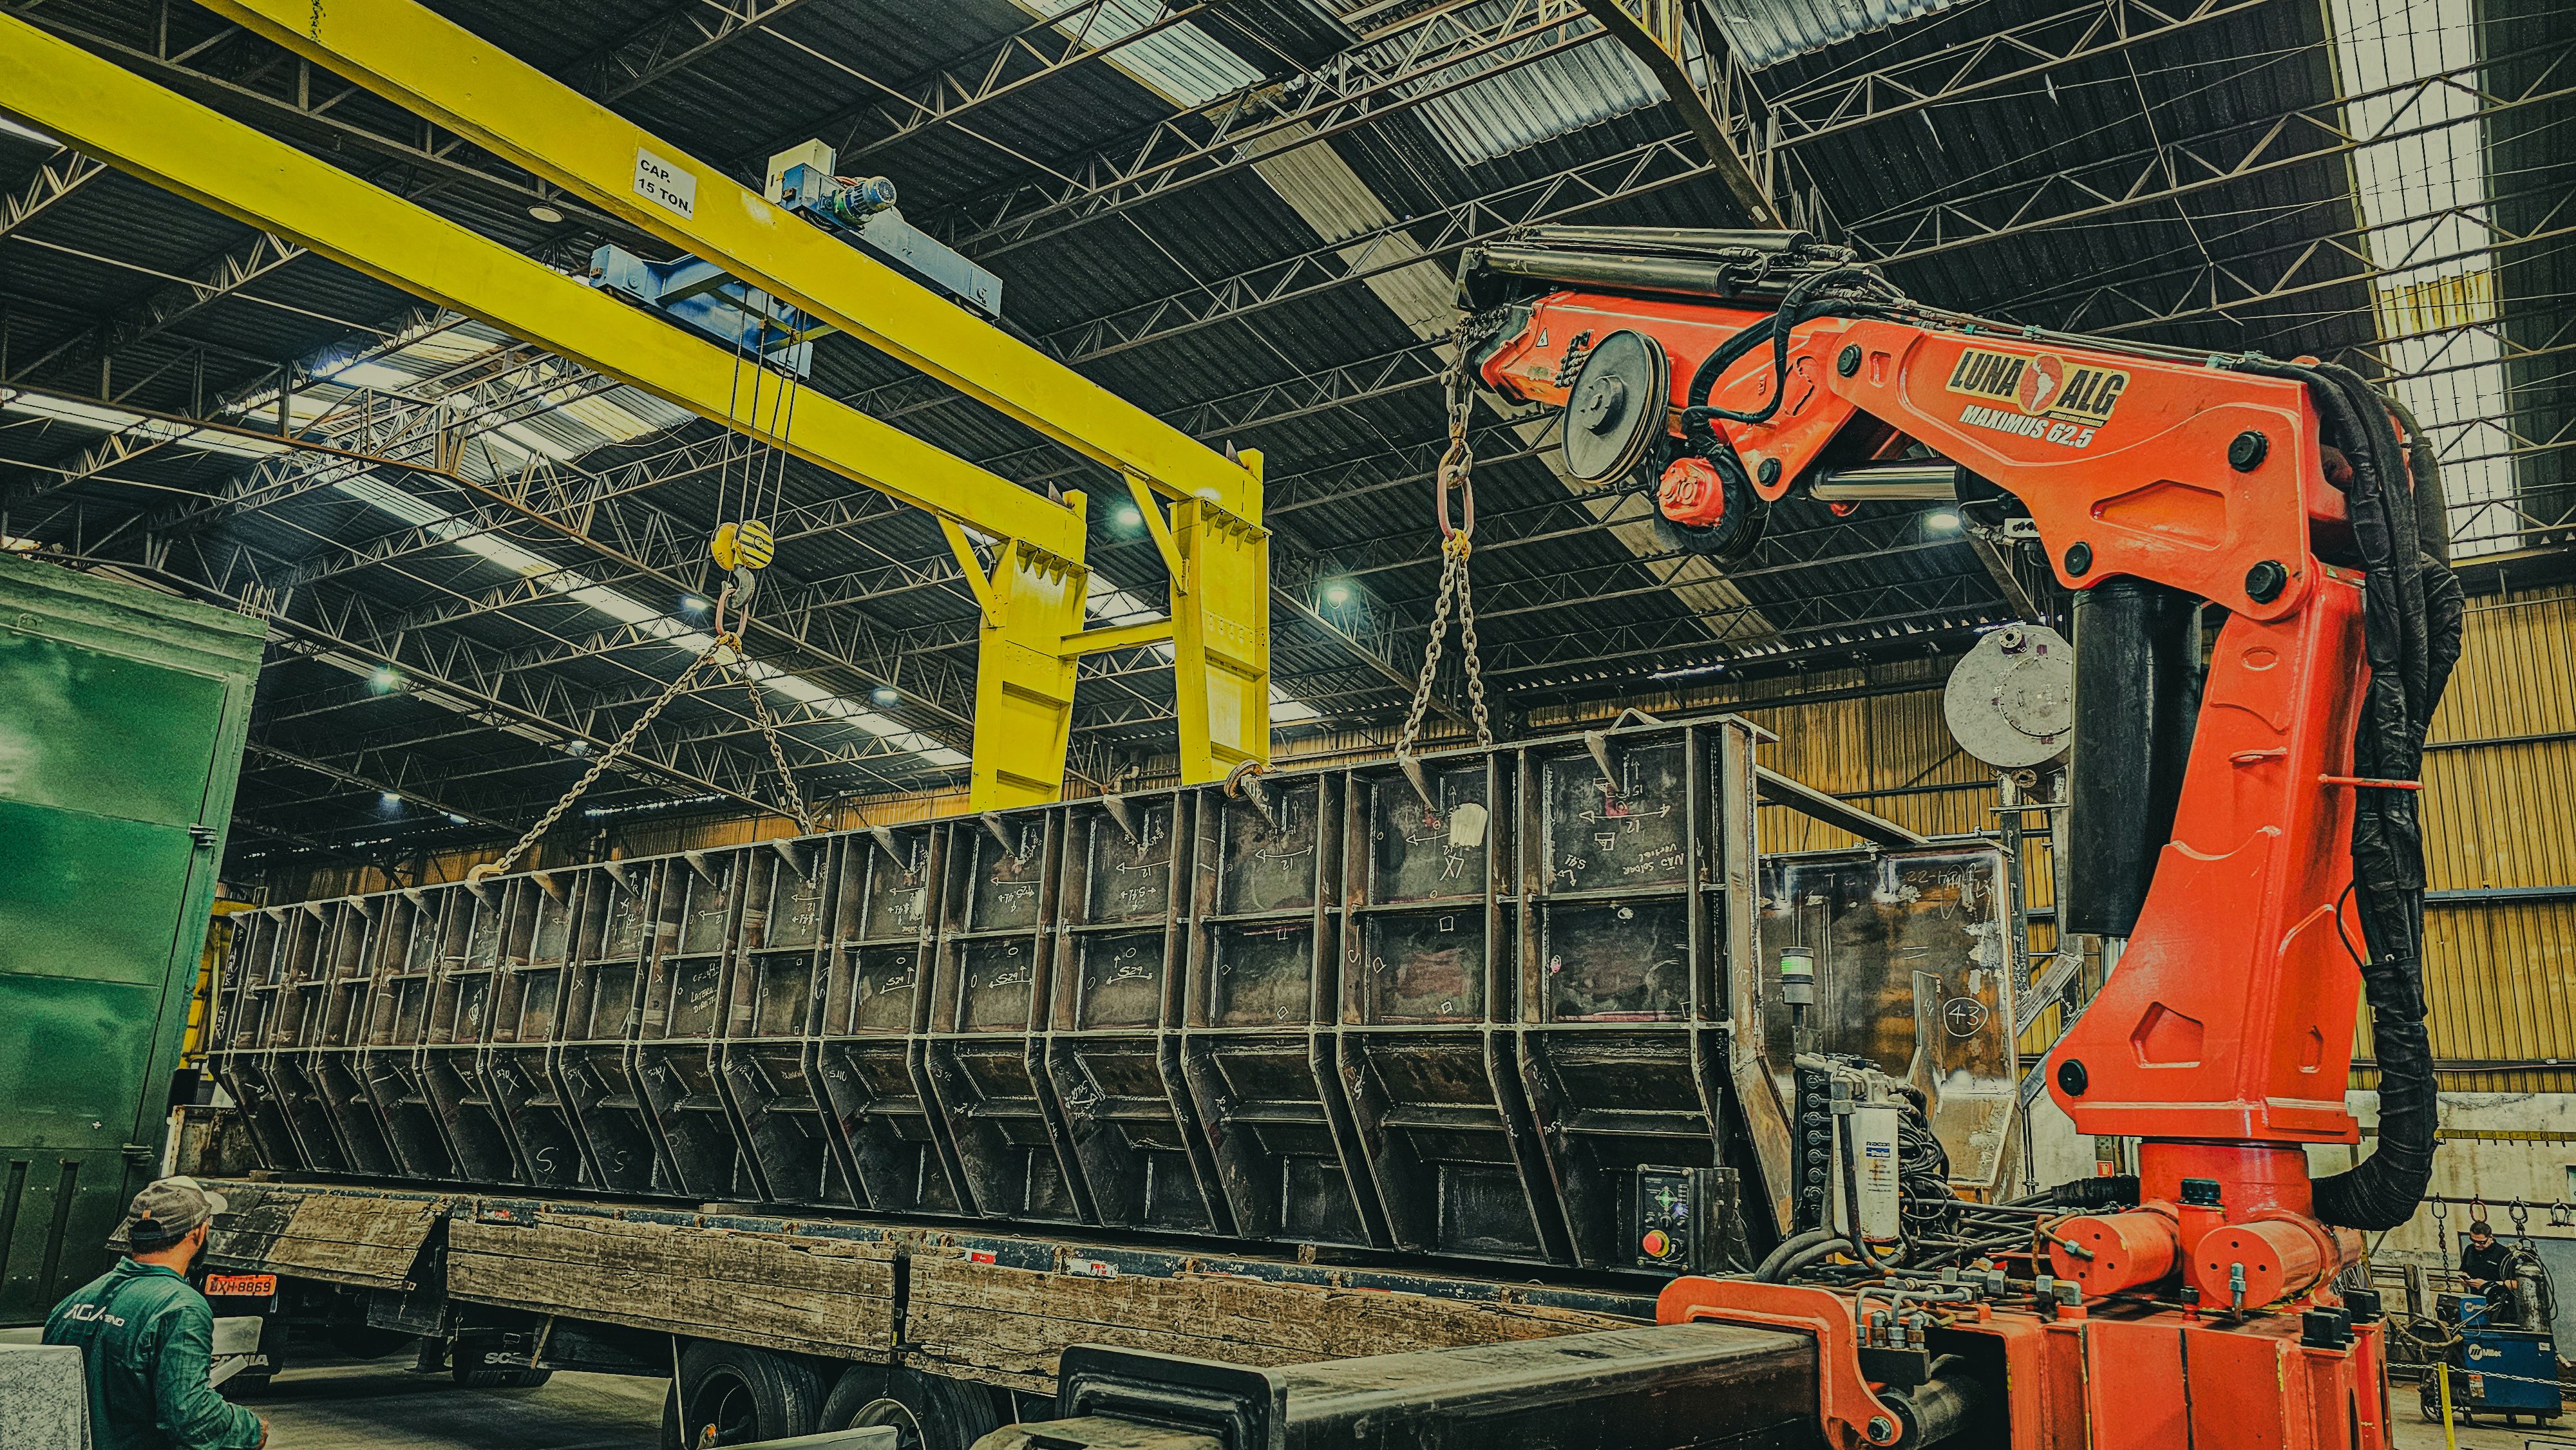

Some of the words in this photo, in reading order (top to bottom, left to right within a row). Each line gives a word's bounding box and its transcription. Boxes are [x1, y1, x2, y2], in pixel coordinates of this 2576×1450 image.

[640, 158, 670, 184] CAP.
[638, 176, 656, 195] 15
[659, 188, 692, 214] TON.
[1950, 351, 2025, 397] LUNA
[2056, 369, 2125, 416] ALG
[1959, 404, 2049, 438] MAXIMUS
[2045, 422, 2096, 449] 62.5
[1625, 820, 1640, 833] 12
[1281, 858, 1293, 870] 12
[1661, 853, 1684, 871] NÃO
[1142, 867, 1151, 877] 12
[807, 903, 815, 911] 12
[716, 915, 723, 924] 12
[1948, 1003, 1980, 1026] 43
